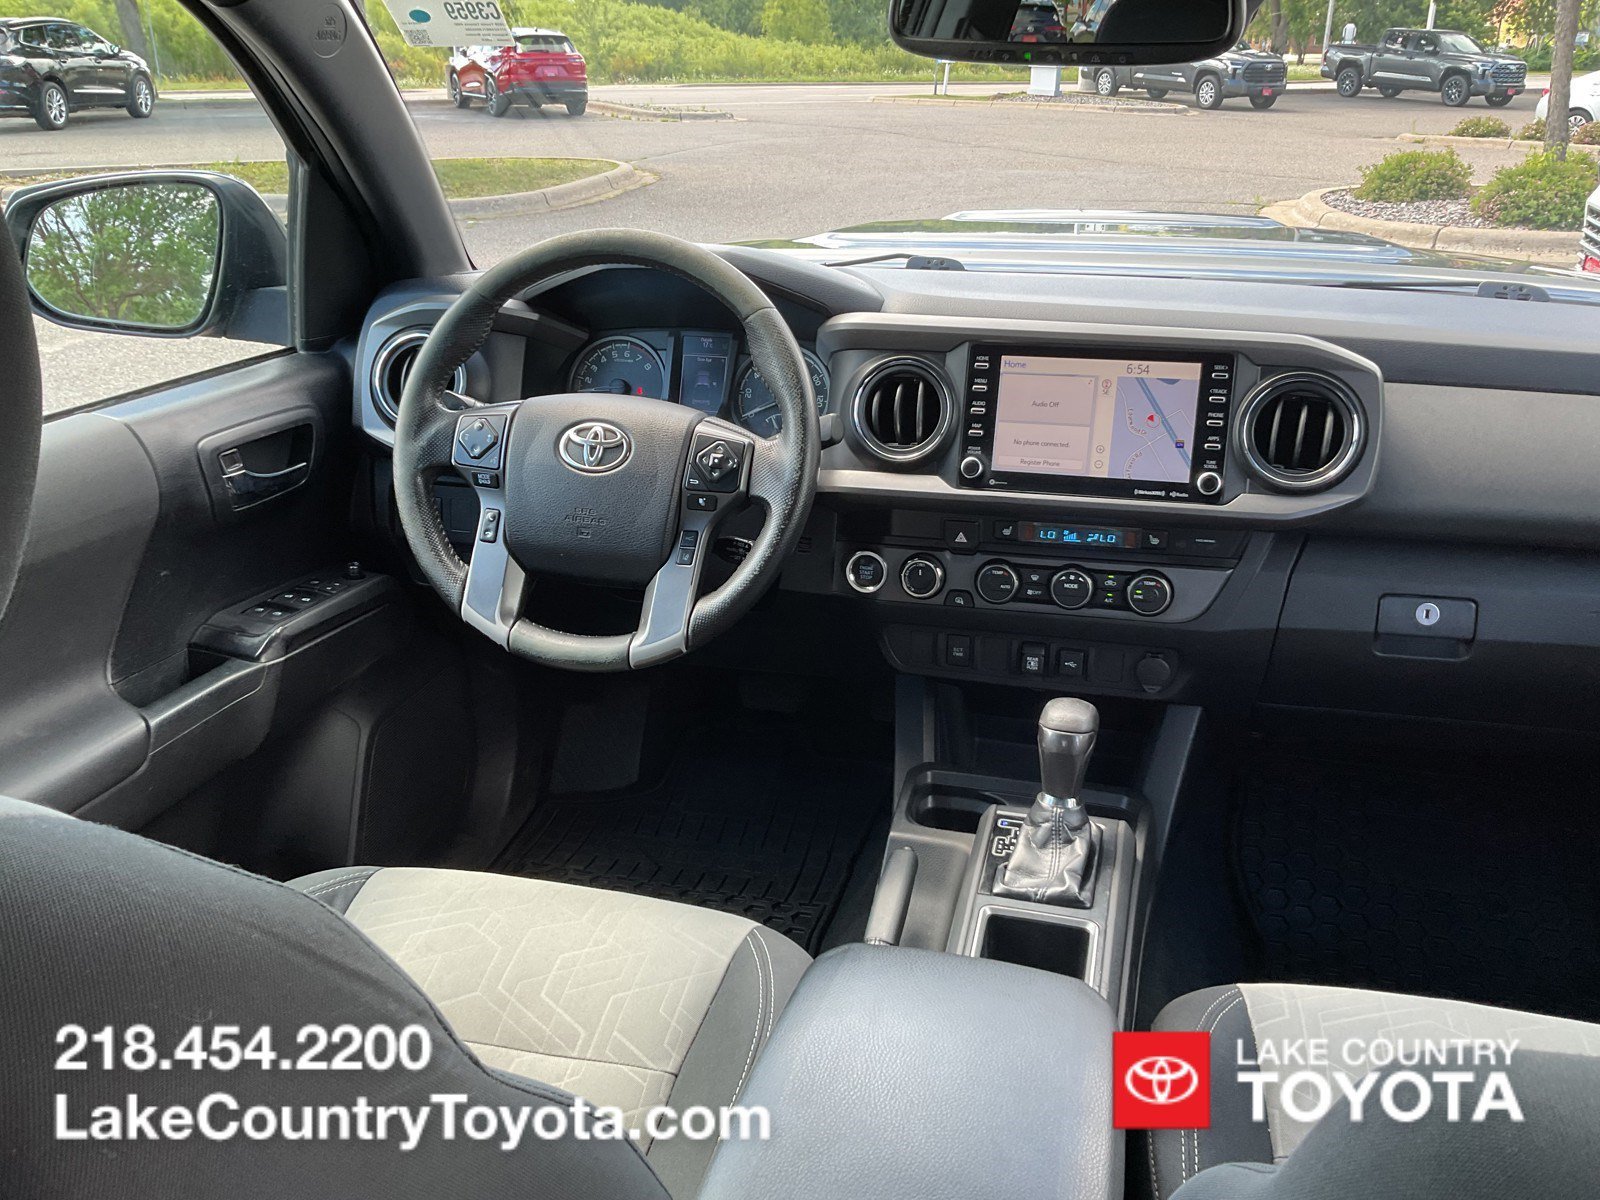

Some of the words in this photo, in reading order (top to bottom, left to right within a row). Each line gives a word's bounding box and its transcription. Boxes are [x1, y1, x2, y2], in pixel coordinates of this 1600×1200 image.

[591, 364, 598, 372] 3
[1004, 360, 1026, 368] Home
[1126, 363, 1150, 374] 6:54
[812, 374, 821, 386] 100
[745, 388, 752, 399] 20
[1023, 440, 1040, 448] phone
